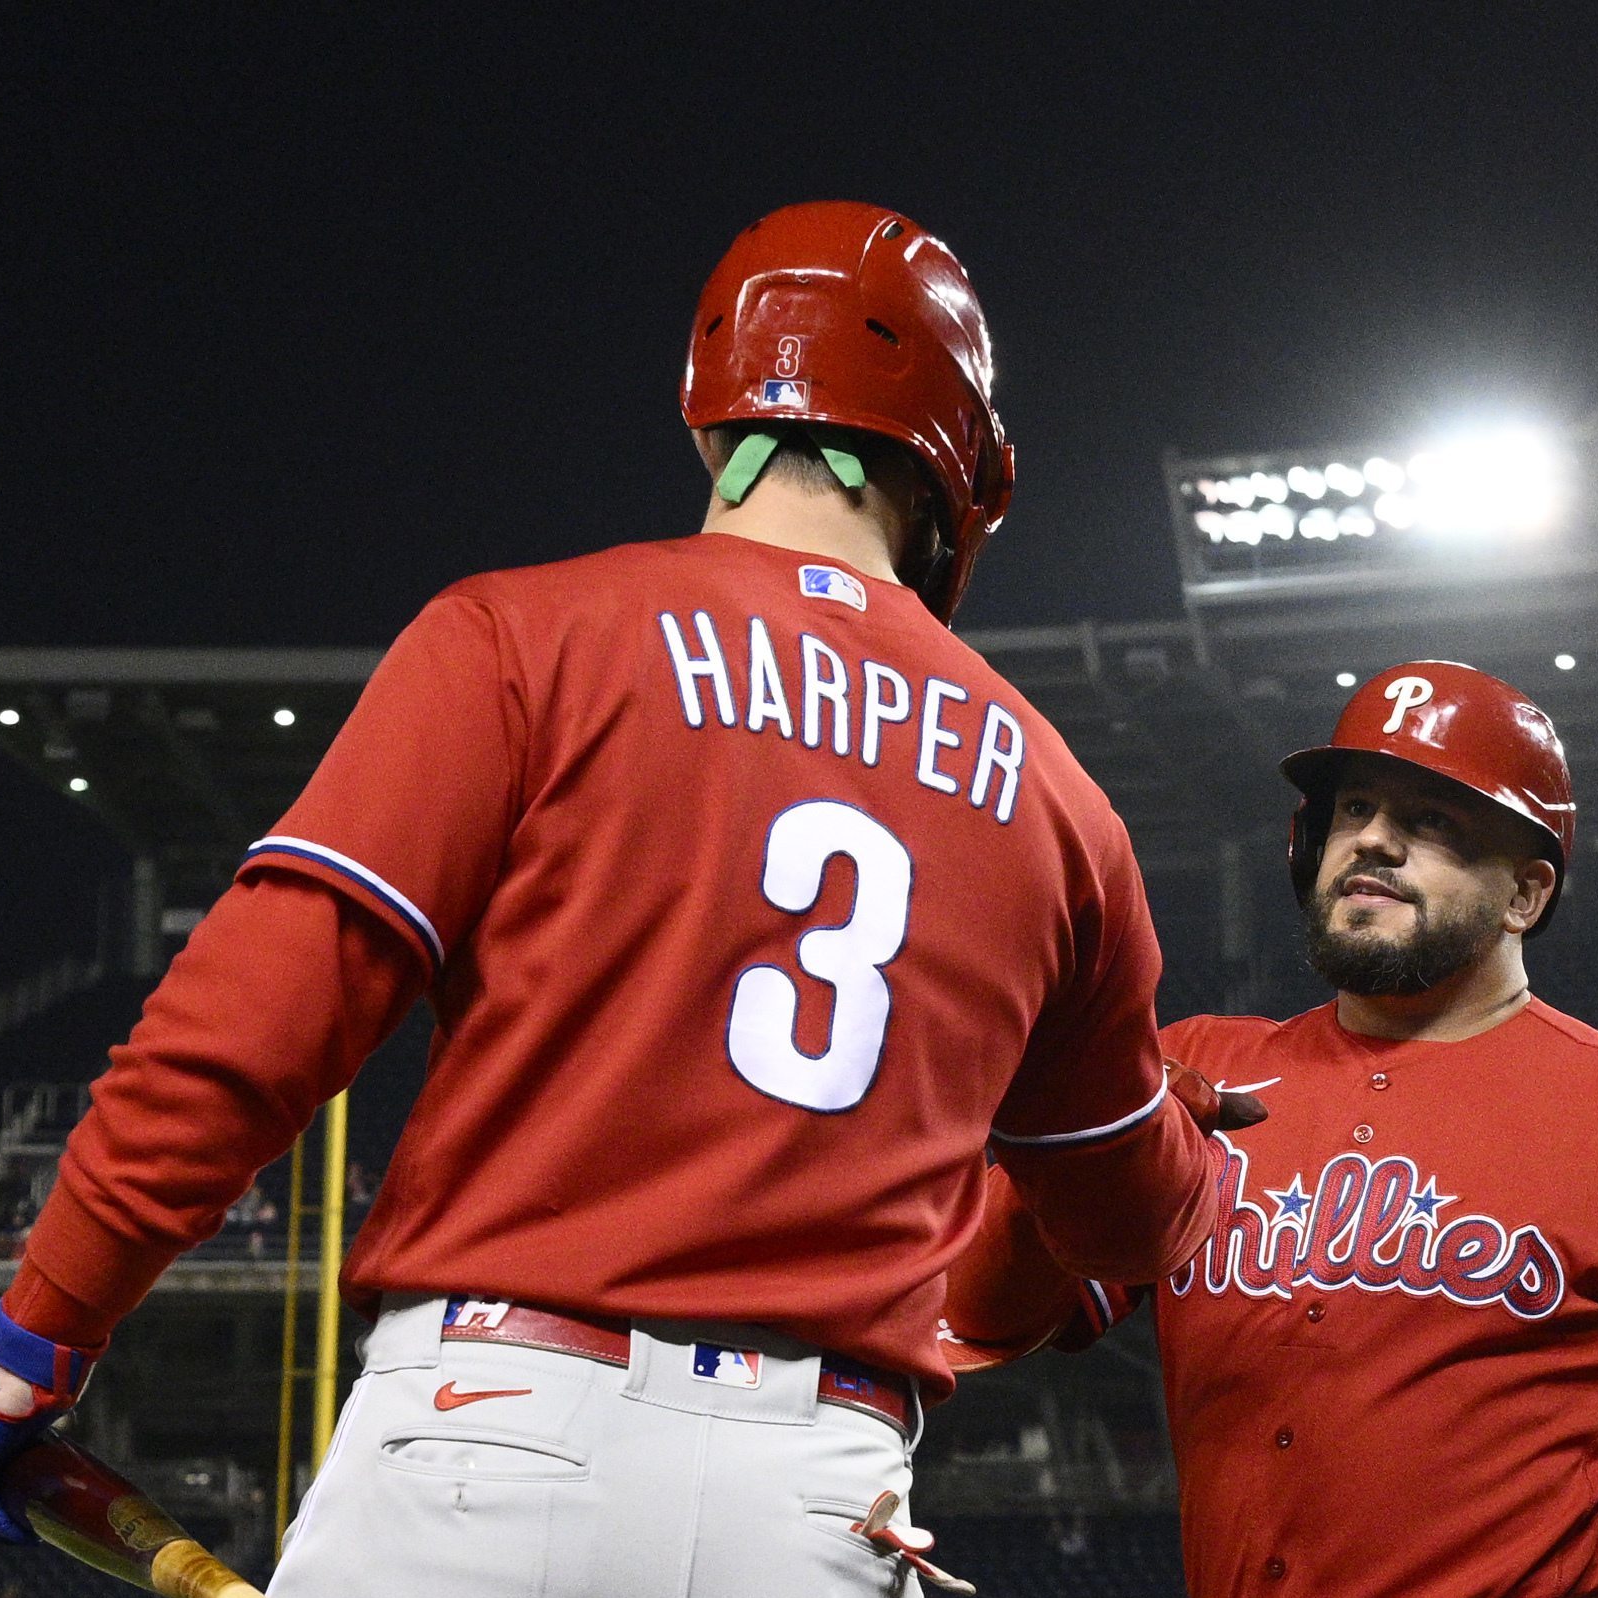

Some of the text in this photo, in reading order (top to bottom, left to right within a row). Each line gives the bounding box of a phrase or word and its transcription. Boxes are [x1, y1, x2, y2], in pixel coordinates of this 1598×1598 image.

[775, 336, 801, 378] 3
[659, 610, 1025, 824] HARPER
[1382, 676, 1434, 735] P
[726, 799, 914, 1114] 3
